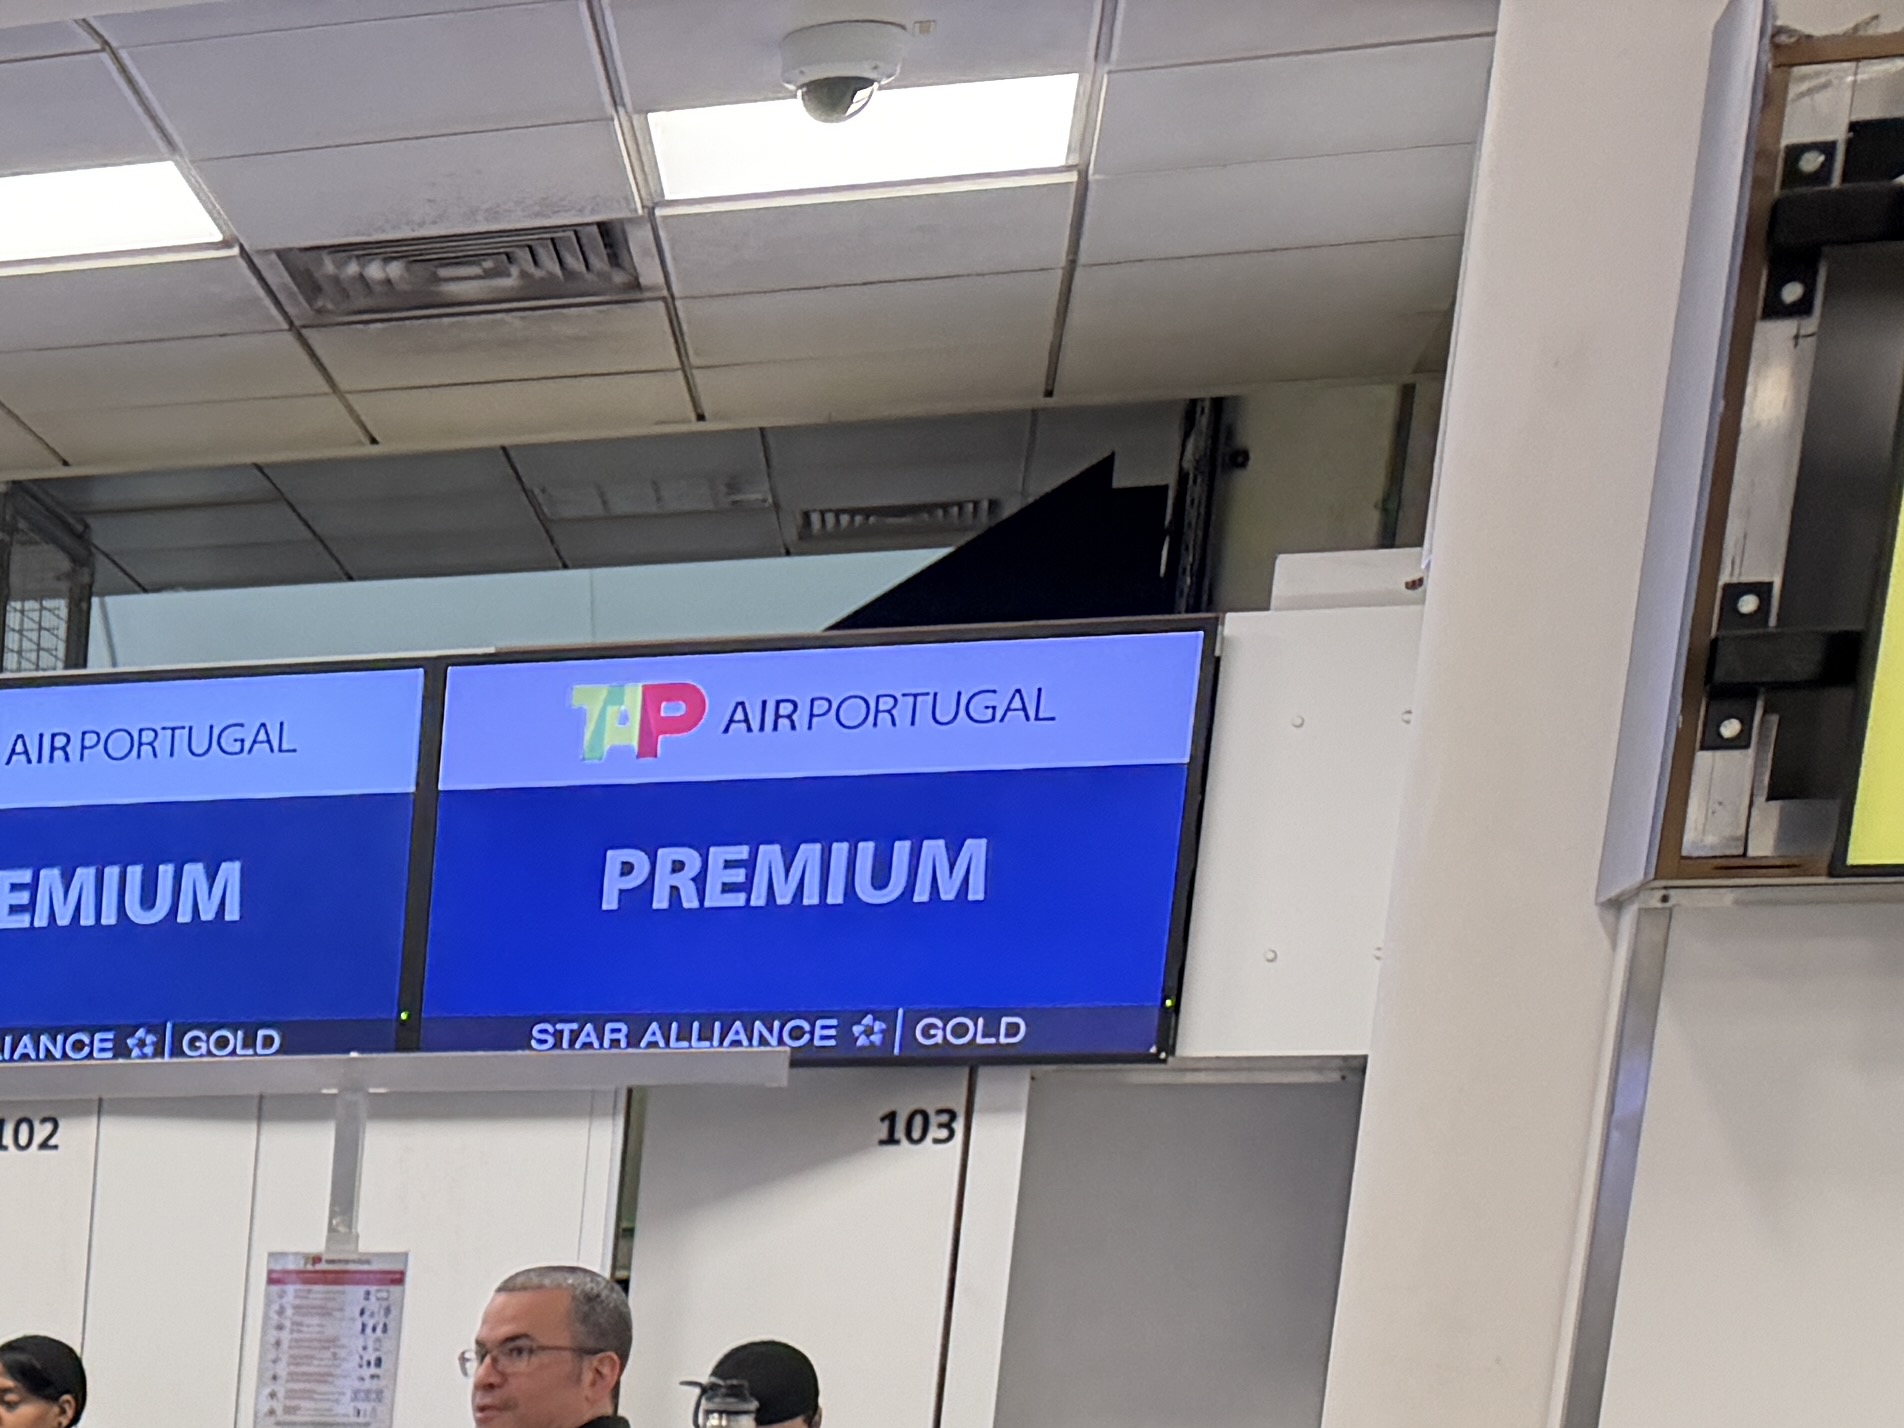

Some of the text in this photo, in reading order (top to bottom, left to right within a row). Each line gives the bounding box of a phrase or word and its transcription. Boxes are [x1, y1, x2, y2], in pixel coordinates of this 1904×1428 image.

[571, 681, 708, 763] TAP
[601, 837, 988, 911] PREMIUM
[181, 1027, 282, 1057] GOLD
[530, 1016, 1027, 1051] STAR ALLIANCE GOLD
[878, 1108, 957, 1146] 103
